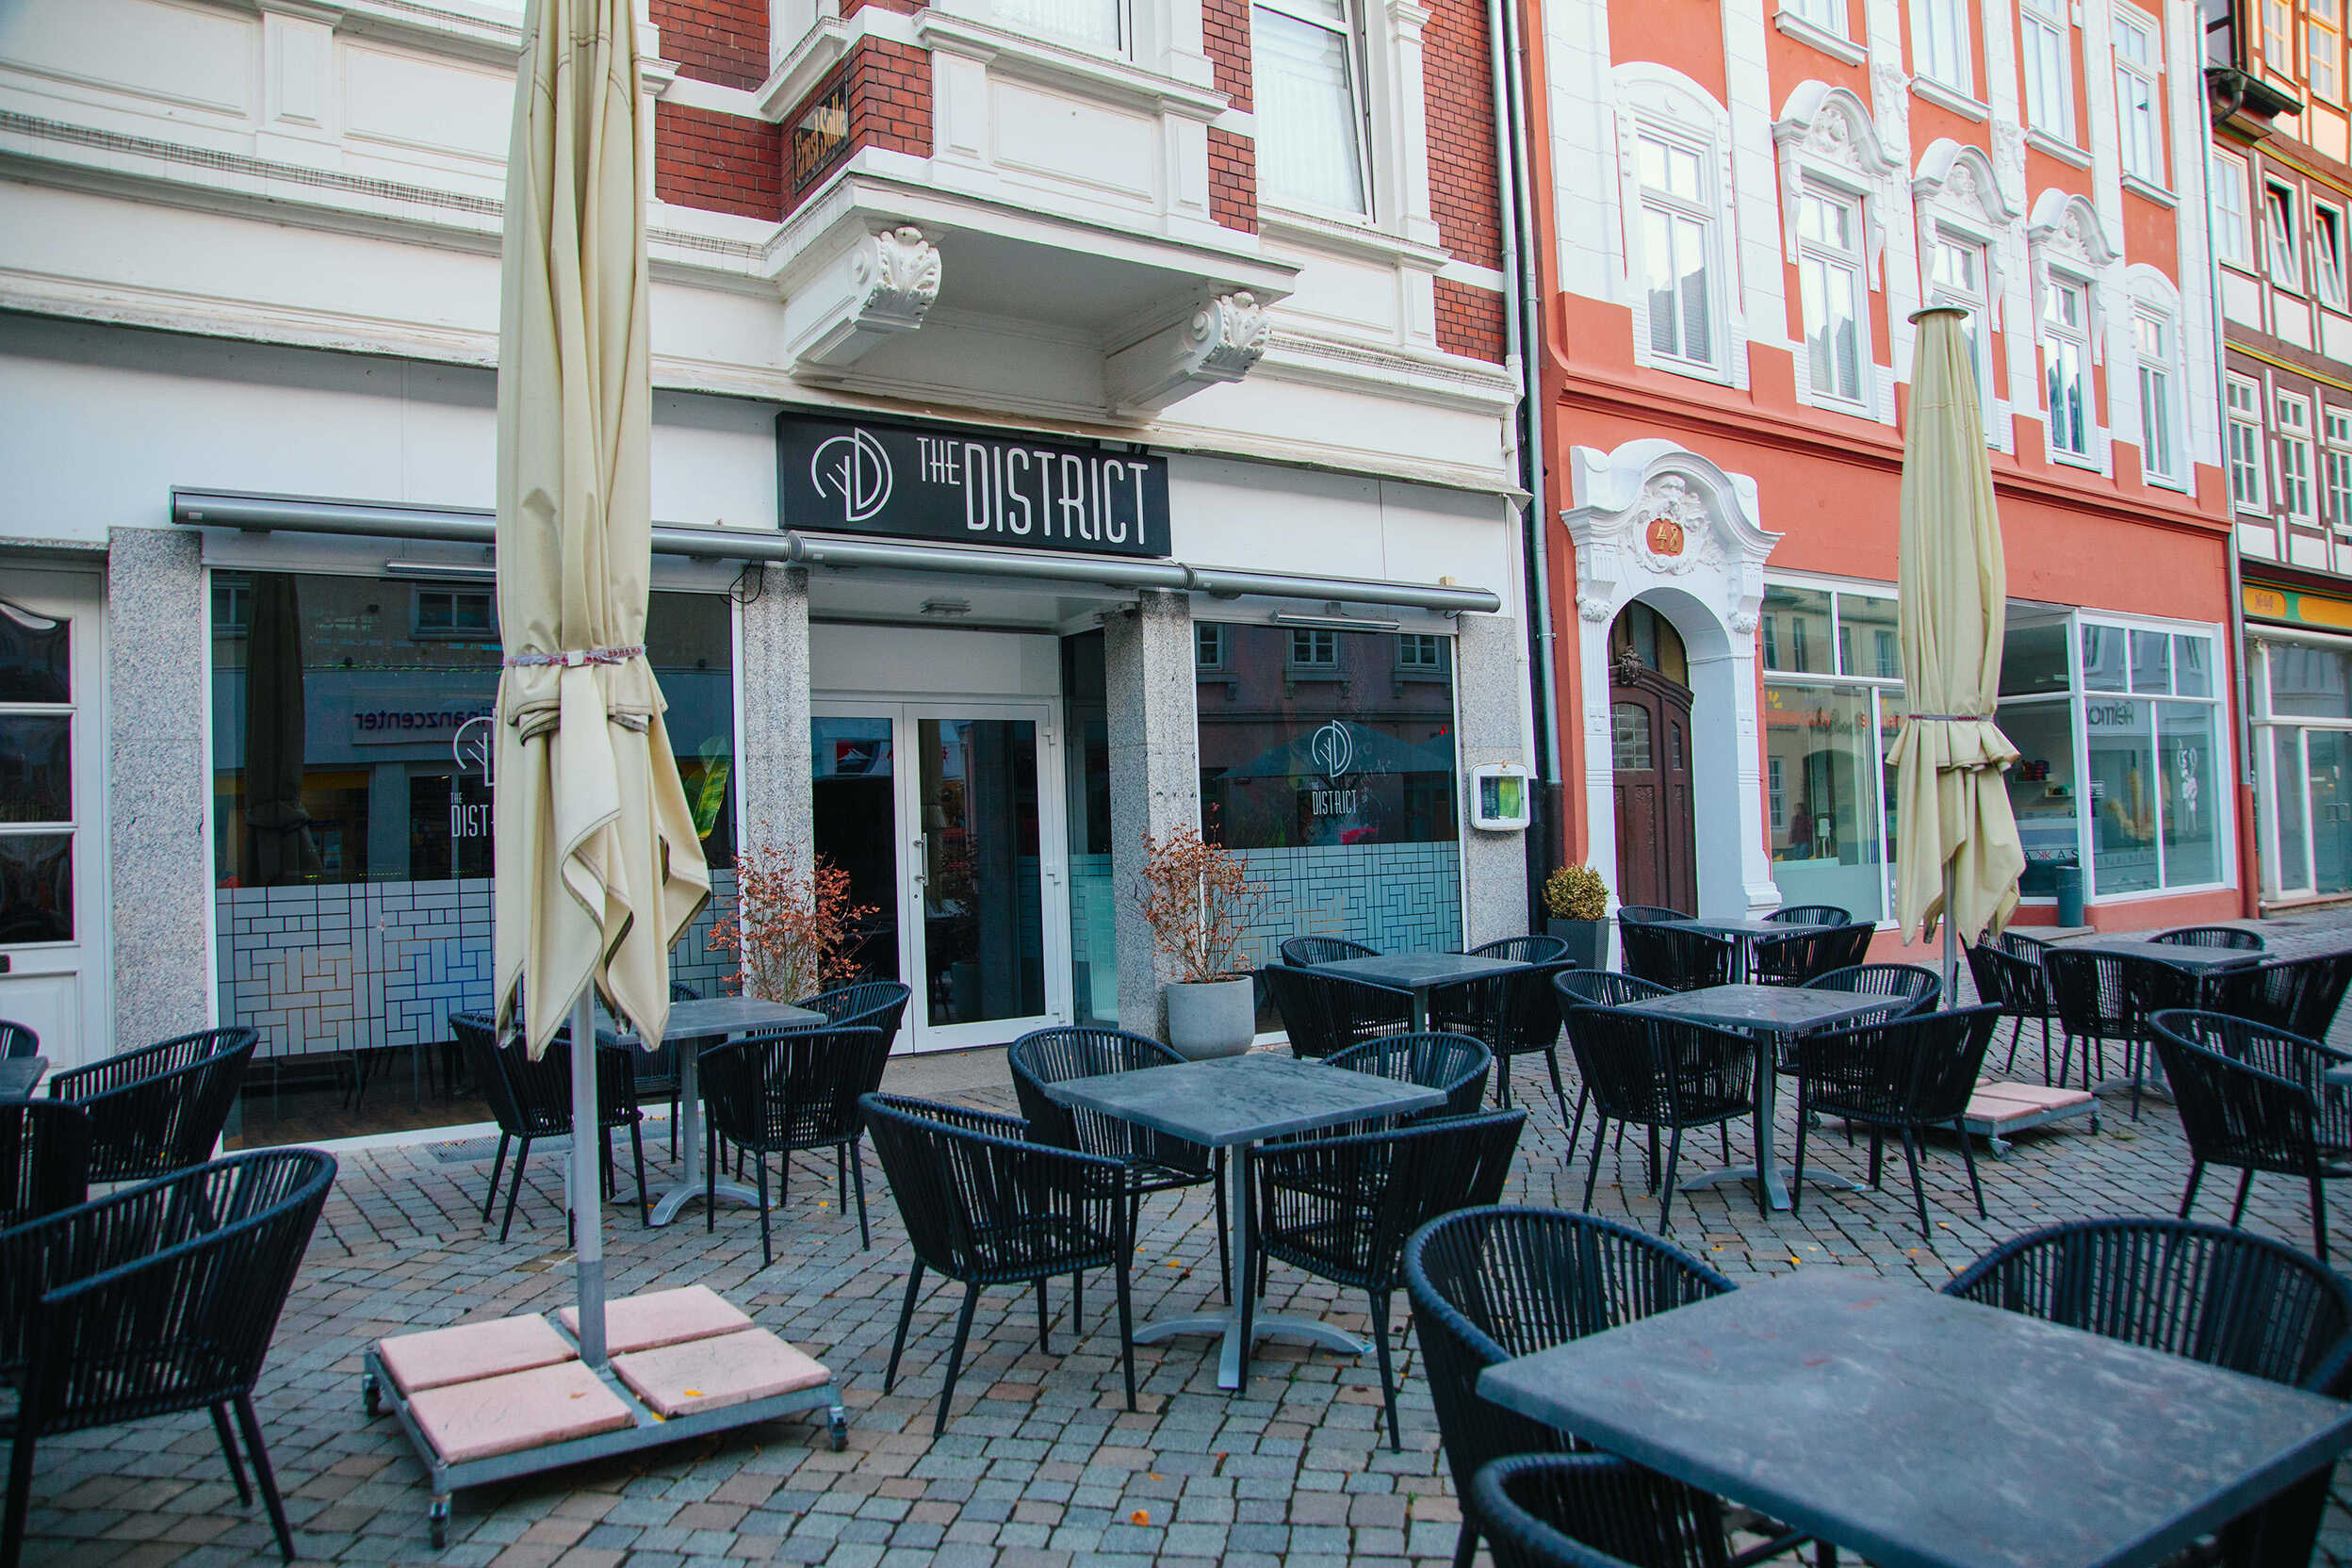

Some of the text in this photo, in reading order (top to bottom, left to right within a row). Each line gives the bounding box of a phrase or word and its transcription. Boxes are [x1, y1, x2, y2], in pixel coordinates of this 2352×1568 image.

[916, 436, 1149, 546] THE DISTRICT
[450, 792, 463, 804] THE
[1312, 790, 1357, 815] DISTRICT
[450, 804, 495, 838] DIST
